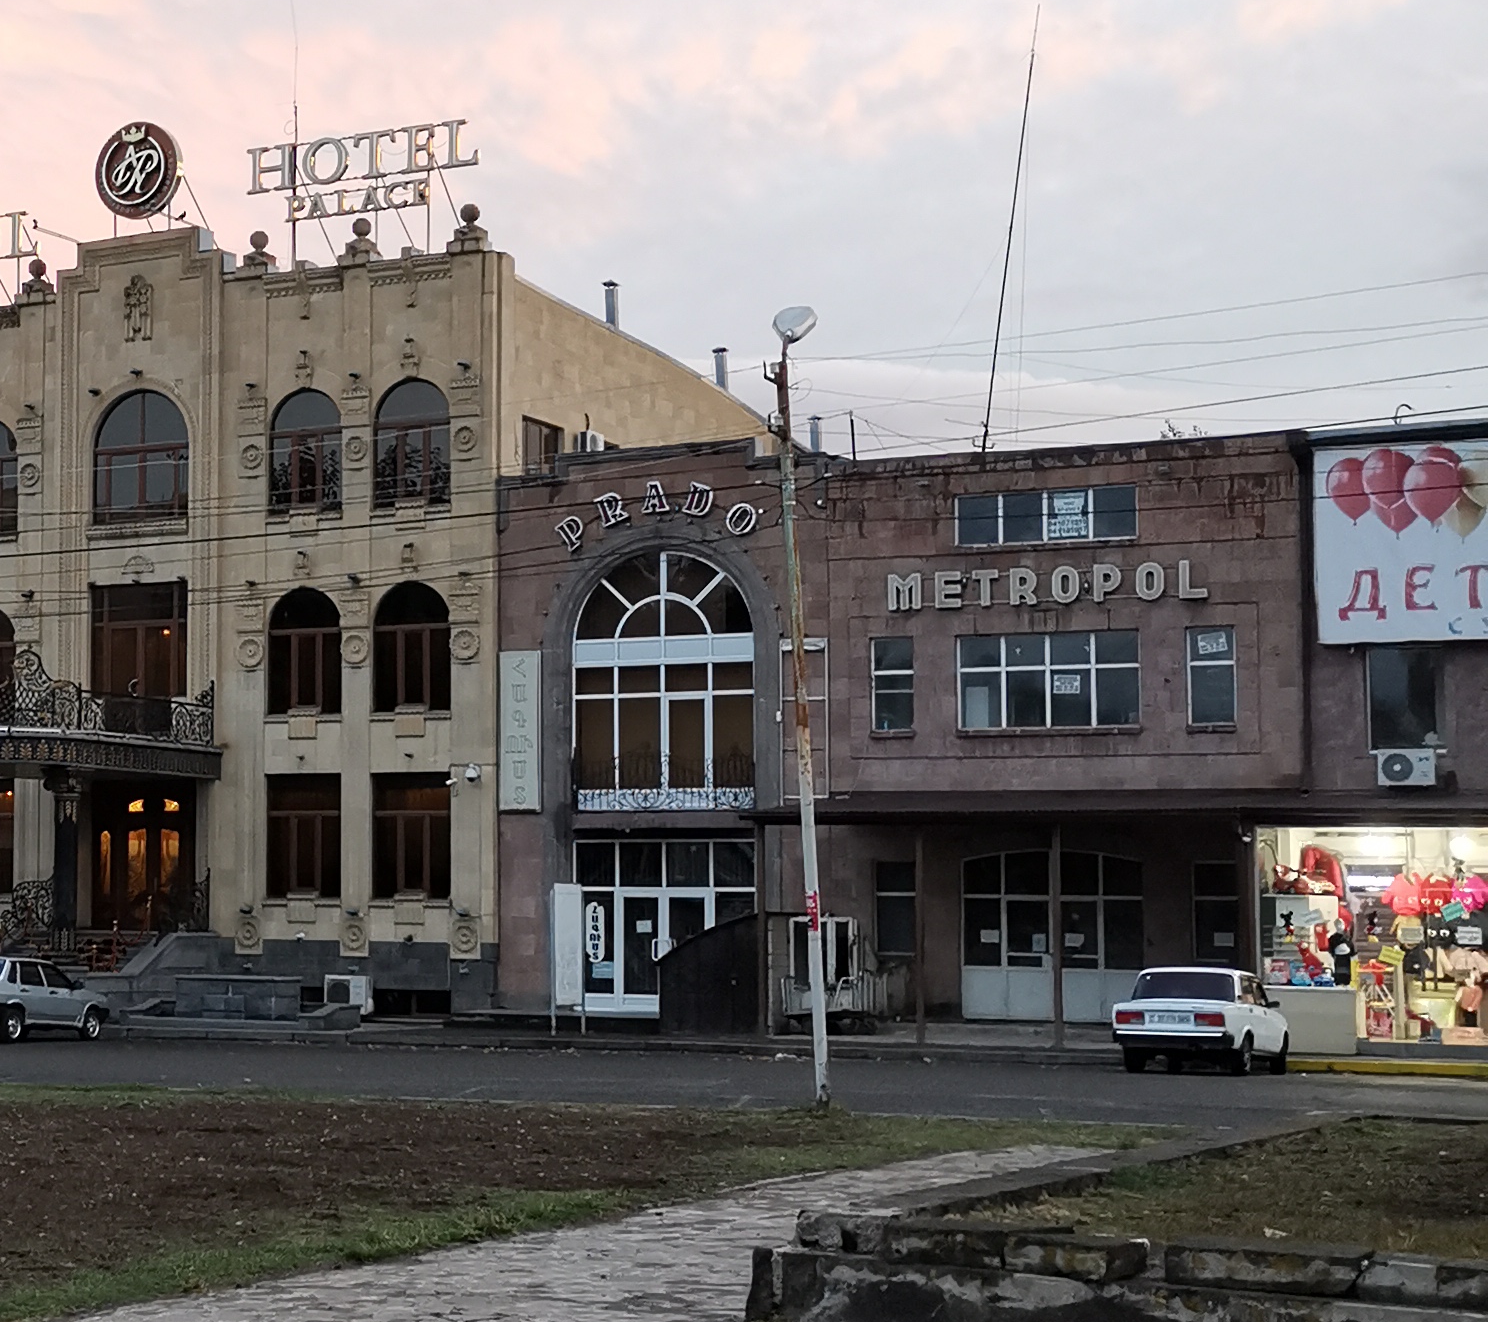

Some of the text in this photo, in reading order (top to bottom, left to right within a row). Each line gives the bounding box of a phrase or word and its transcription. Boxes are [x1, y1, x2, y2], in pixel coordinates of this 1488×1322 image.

[246, 119, 481, 195] HOTEL
[284, 177, 430, 223] PALACE
[555, 480, 757, 552] PRADO
[887, 559, 1209, 612] METROPOL
